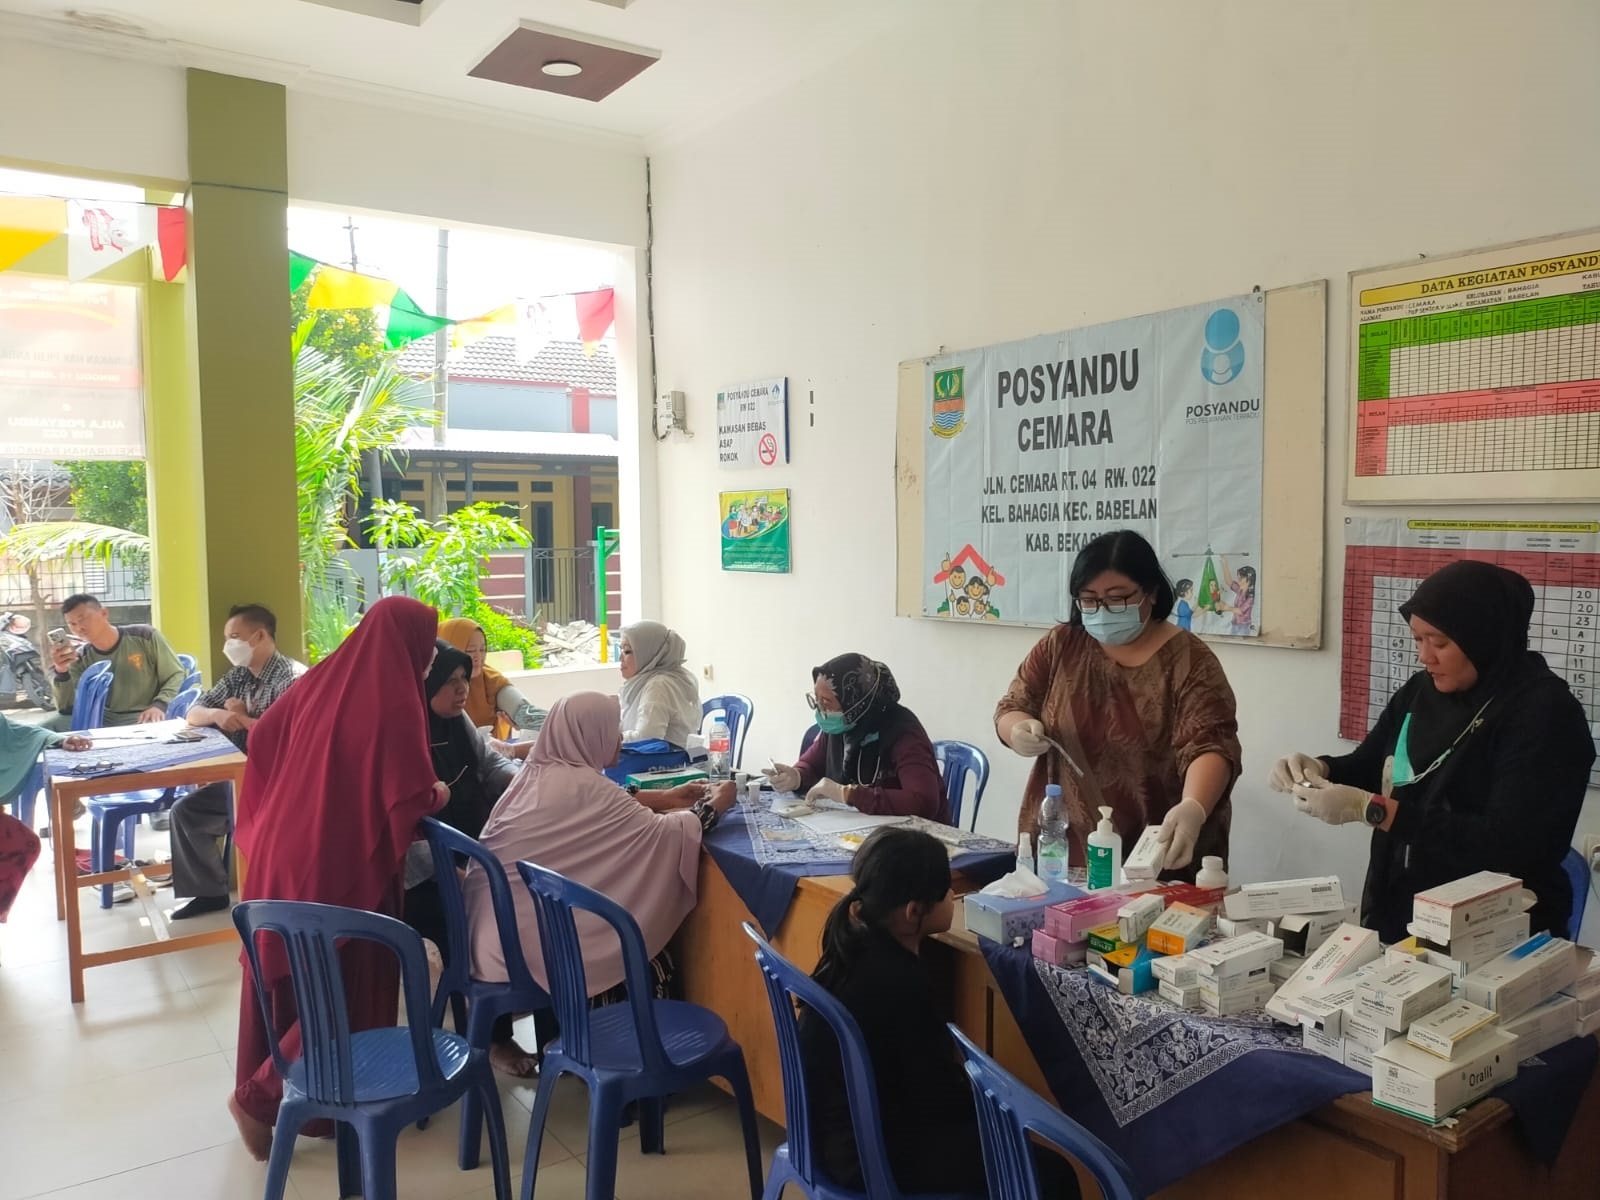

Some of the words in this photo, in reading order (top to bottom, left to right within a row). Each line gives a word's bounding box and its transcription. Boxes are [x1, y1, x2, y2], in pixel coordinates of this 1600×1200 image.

[1421, 281, 1454, 294] DATA
[1458, 268, 1527, 287] KEGIATAN
[1530, 254, 1600, 276] POSYAND
[998, 348, 1139, 408] POSYANDU
[1186, 399, 1260, 418] POSYANDU
[747, 421, 767, 432] BEBAS
[1018, 409, 1113, 452] CEMARA
[719, 439, 733, 448] ASAP
[720, 453, 739, 462] ROKOK
[984, 476, 1006, 495] JLN.
[1010, 472, 1058, 493] CEMARA
[1061, 471, 1078, 490] RT.
[1082, 470, 1097, 489] 04
[1104, 467, 1128, 488] RW.
[1132, 465, 1156, 486] 022
[981, 505, 1005, 524] KEL.
[1009, 502, 1060, 523] BAHAGIA
[1063, 501, 1091, 521] KEC.
[1096, 499, 1157, 520] BABELAN
[1026, 533, 1053, 552] KAB.
[1576, 590, 1592, 599] 20
[1577, 604, 1593, 613] 20
[1576, 617, 1590, 626] 23
[1392, 639, 1404, 648] 69
[1573, 644, 1585, 654] 17
[1392, 652, 1403, 662] 59
[1573, 658, 1584, 668] 11
[1573, 674, 1586, 683] 15
[1469, 1065, 1493, 1086] Oralit
